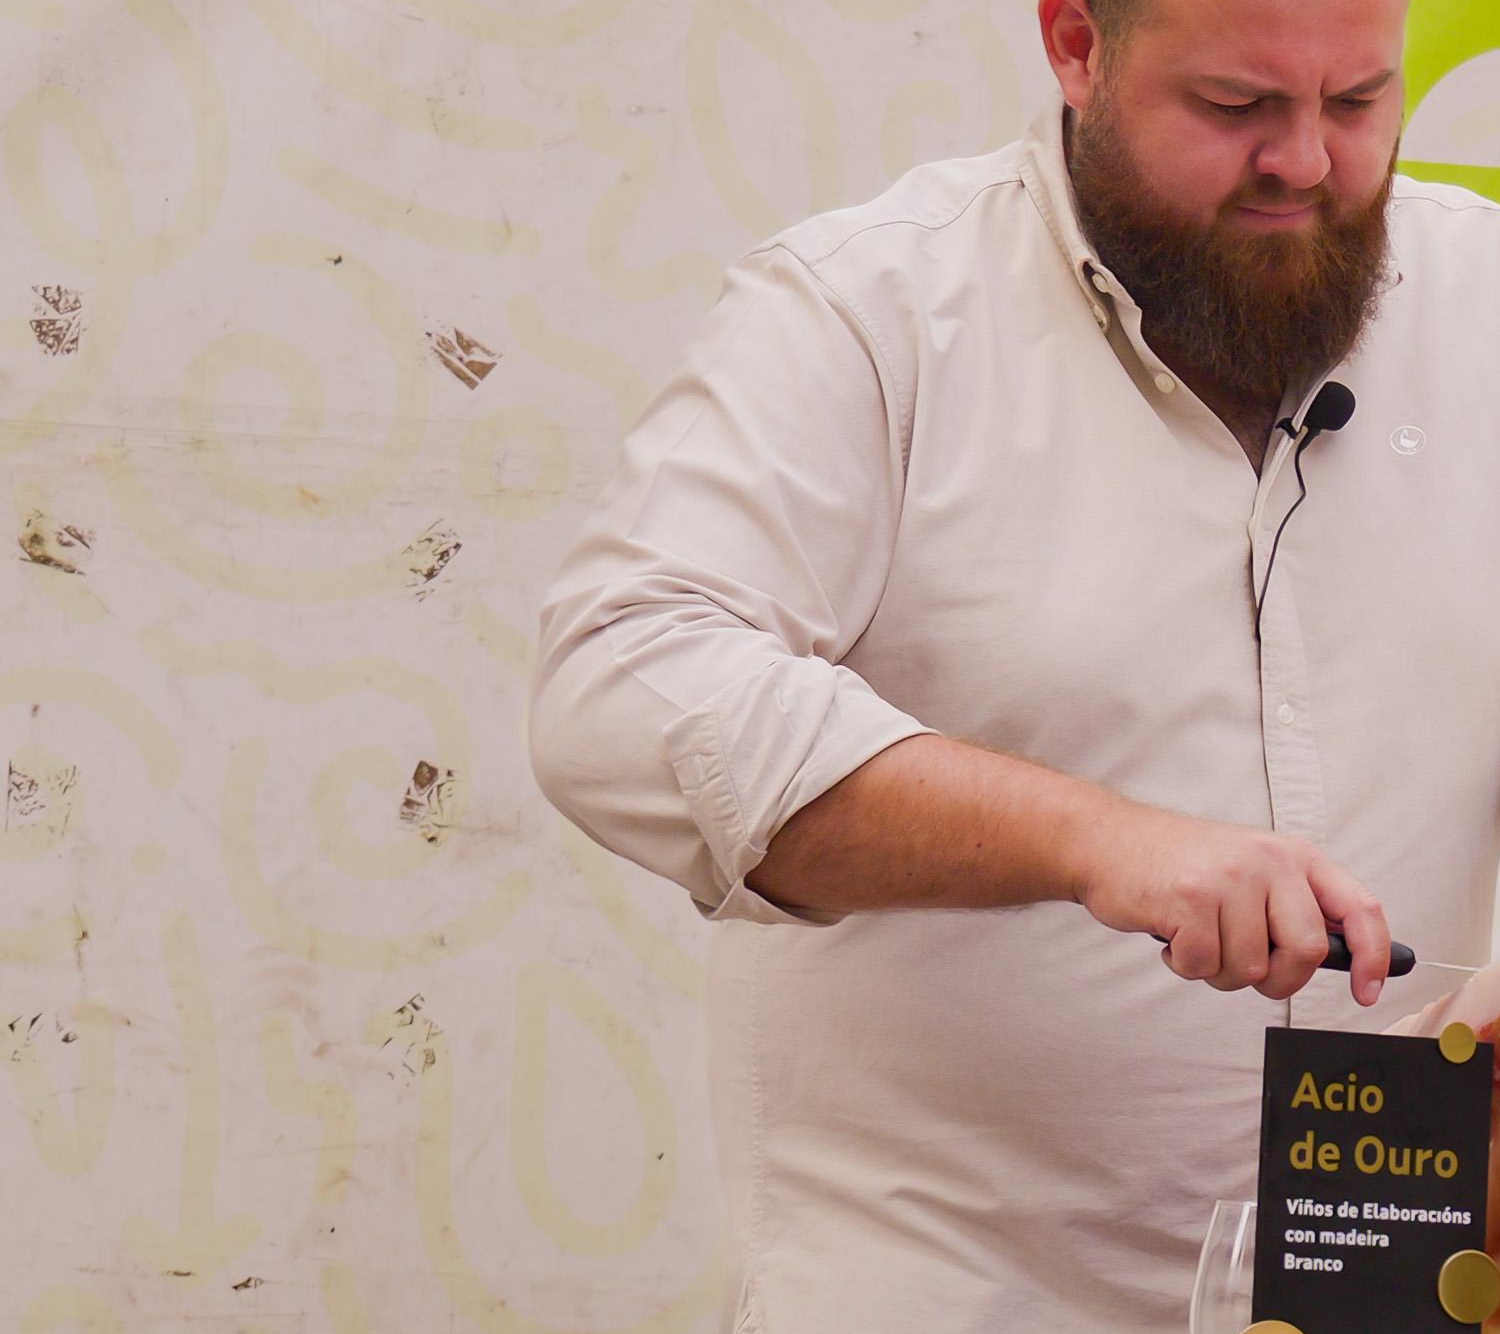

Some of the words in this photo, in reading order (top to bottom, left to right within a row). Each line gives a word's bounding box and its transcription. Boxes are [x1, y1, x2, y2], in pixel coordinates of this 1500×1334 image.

[1291, 1072, 1384, 1114] Acio
[1289, 1131, 1341, 1171] de
[1354, 1136, 1458, 1178] Ouro
[1286, 1198, 1333, 1217] Viños
[1337, 1202, 1358, 1218] de
[1363, 1203, 1471, 1224] Elaboracións
[1285, 1229, 1316, 1243] con
[1320, 1229, 1389, 1247] madeira
[1284, 1253, 1343, 1271] Branco
